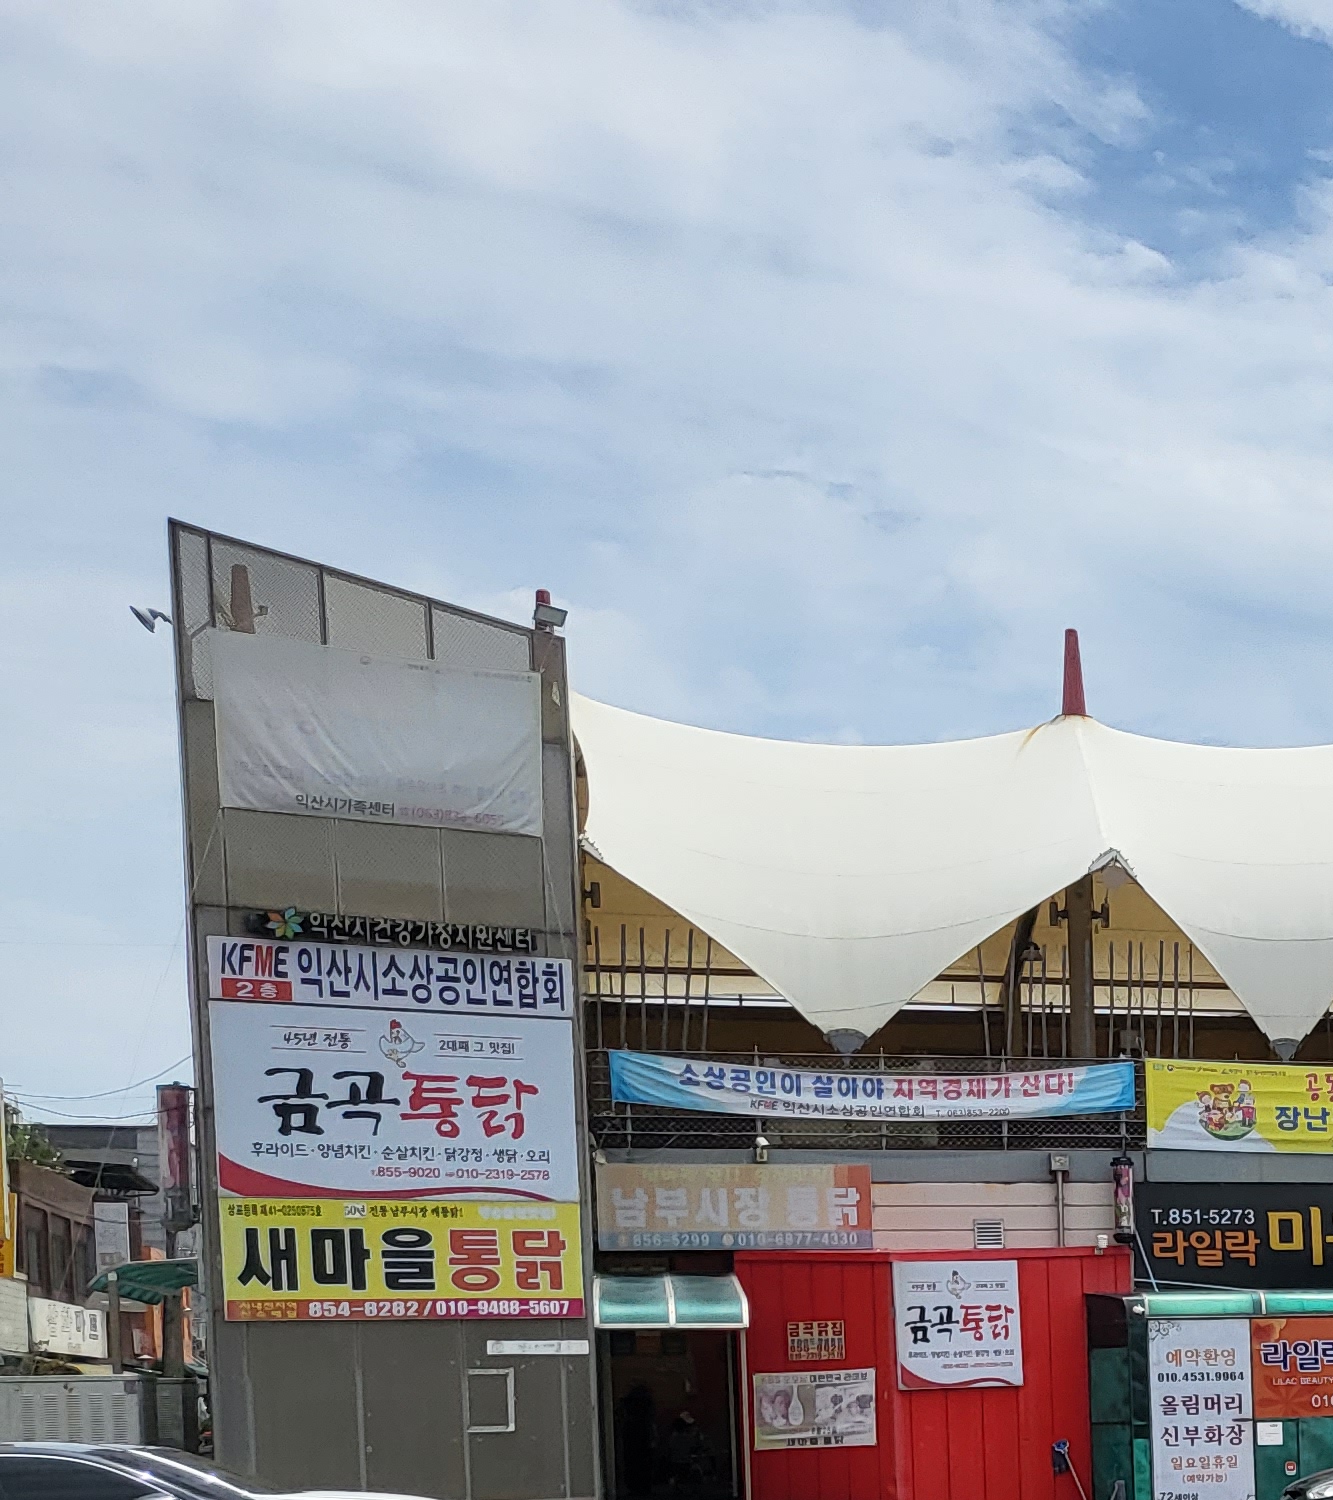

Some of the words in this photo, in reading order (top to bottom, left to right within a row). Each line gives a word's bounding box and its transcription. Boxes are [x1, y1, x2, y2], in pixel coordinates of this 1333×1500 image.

[296, 794, 395, 817] 익산시가족센터
[309, 914, 532, 951] 익산시건강가정지원센터
[221, 942, 289, 979] KFME
[297, 947, 565, 1011] 익산시소상공인연합회
[235, 981, 279, 999] 2층
[323, 1032, 352, 1048] 전통
[677, 1064, 802, 1098] 소상공인이
[812, 1067, 884, 1099] 살아야
[893, 1070, 1011, 1100] 지역경제가
[1021, 1069, 1074, 1098] 산다!
[257, 1067, 539, 1139] 금곡통닭
[783, 1101, 926, 1118] 익산시소상공인연합회
[250, 1142, 309, 1159] 후라이드
[317, 1143, 372, 1160] 양념치킨
[381, 1145, 436, 1161] 순살치킨
[444, 1147, 483, 1163] 닭강정
[492, 1148, 519, 1164] 생닭
[525, 1150, 551, 1164] 오리
[611, 1187, 770, 1227] 남부시장
[1151, 1208, 1255, 1225] T.851-5273
[1152, 1230, 1260, 1267] 라일락
[905, 1304, 1014, 1344] 금곡통닭
[1165, 1348, 1236, 1367] 예약환영
[1160, 1393, 1243, 1415] 올림머리
[1161, 1424, 1245, 1447] 신부화장
[1171, 1455, 1237, 1470] 일요일휴일
